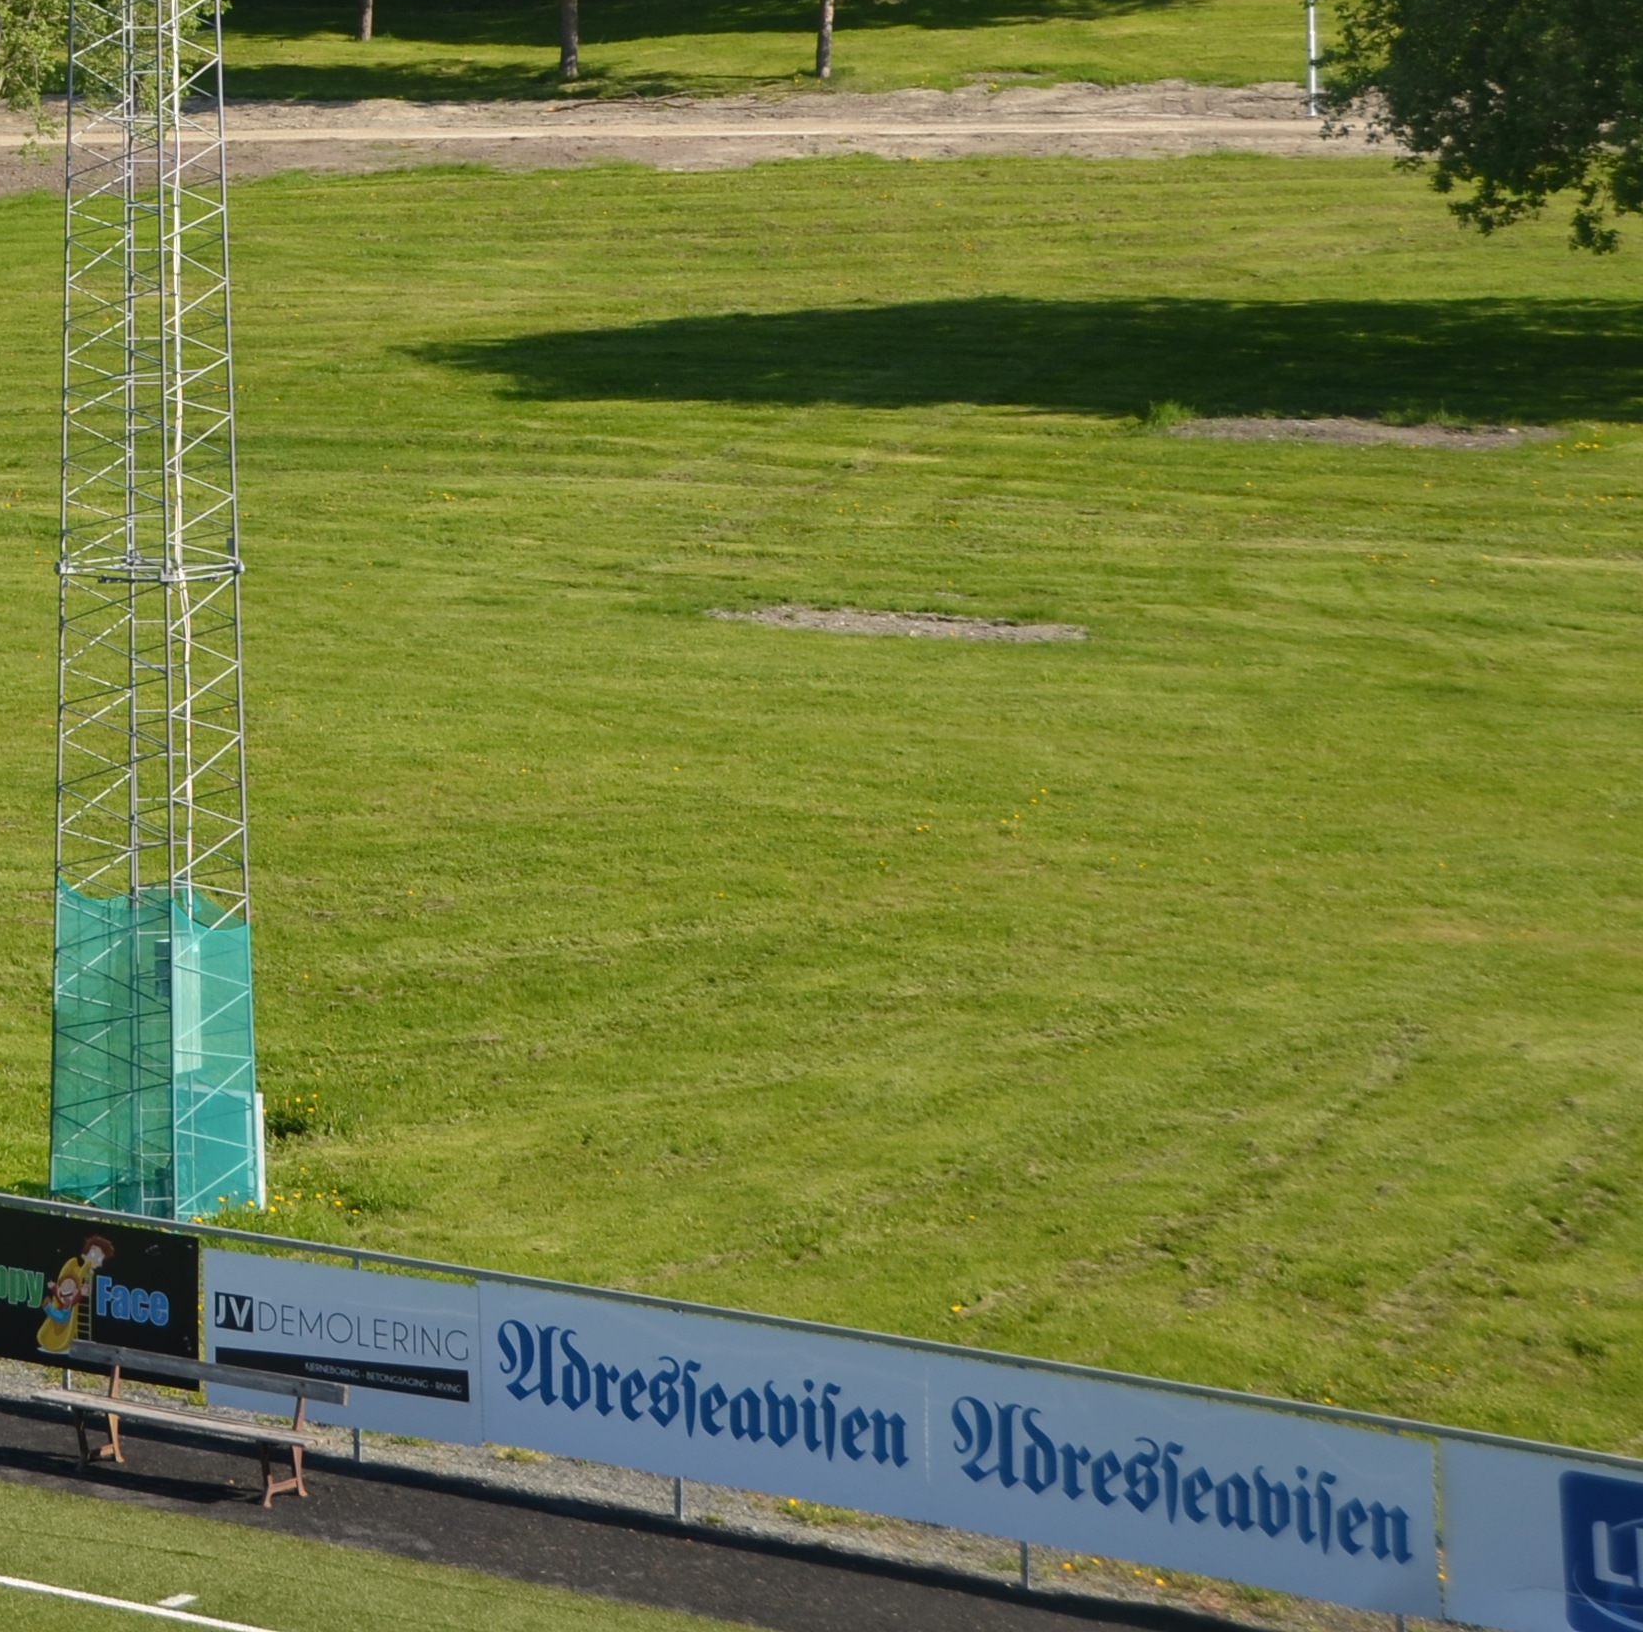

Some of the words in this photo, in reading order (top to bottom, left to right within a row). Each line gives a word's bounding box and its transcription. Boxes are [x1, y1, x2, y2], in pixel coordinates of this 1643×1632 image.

[96, 1274, 170, 1327] Face
[216, 1294, 253, 1329] JV
[258, 1306, 470, 1362] DEMOLERING
[435, 1381, 462, 1394] RIVING
[497, 1318, 910, 1468] Adresseavisen
[951, 1395, 1413, 1565] Adresseavisen
